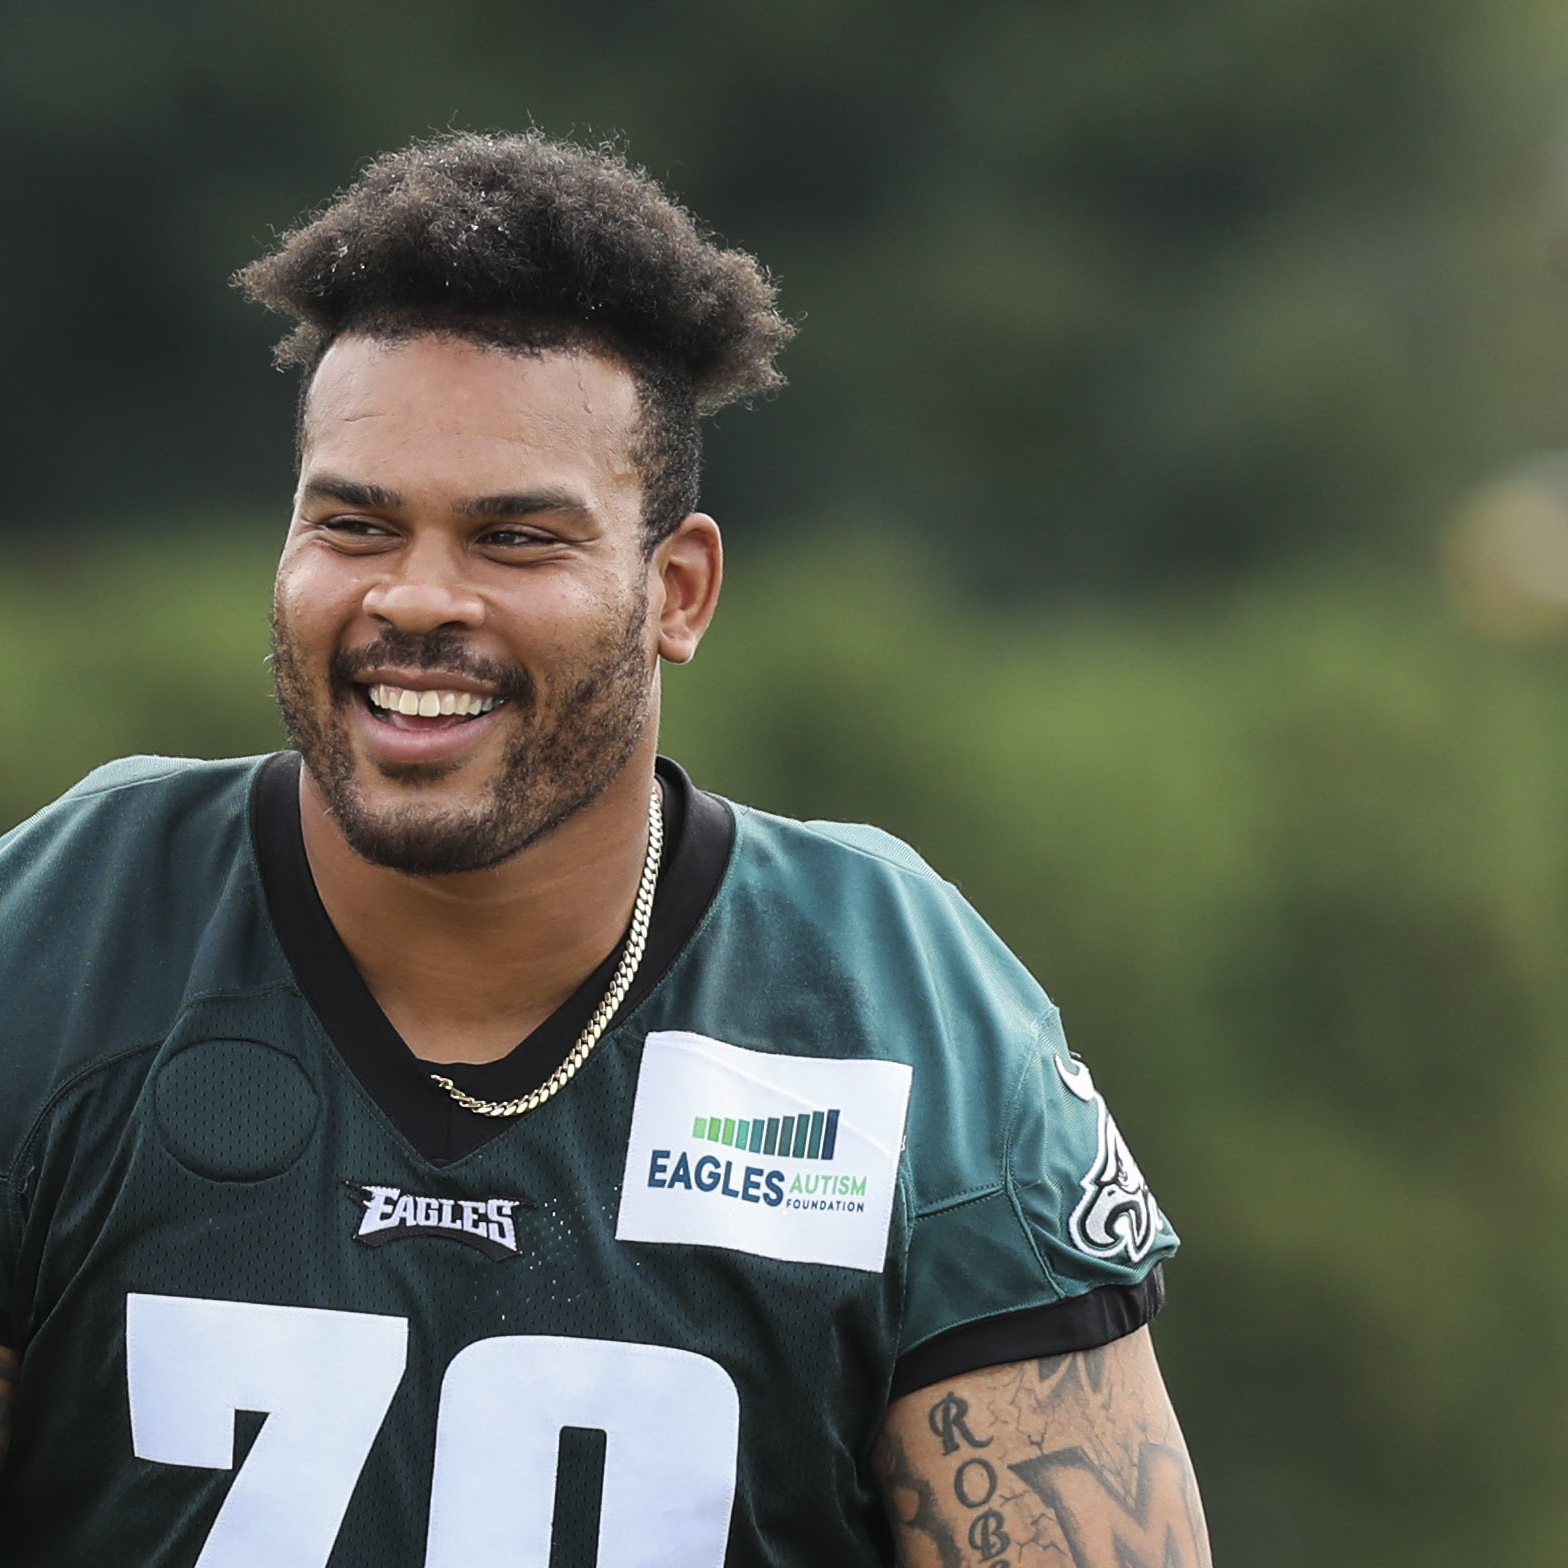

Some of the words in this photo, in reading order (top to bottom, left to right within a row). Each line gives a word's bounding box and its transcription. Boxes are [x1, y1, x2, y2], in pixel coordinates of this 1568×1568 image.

[647, 1149, 785, 1207] EAGLES
[789, 1173, 868, 1197] AUTISM
[786, 1198, 865, 1213] FOUNDATION
[358, 1184, 520, 1251] EAGLES
